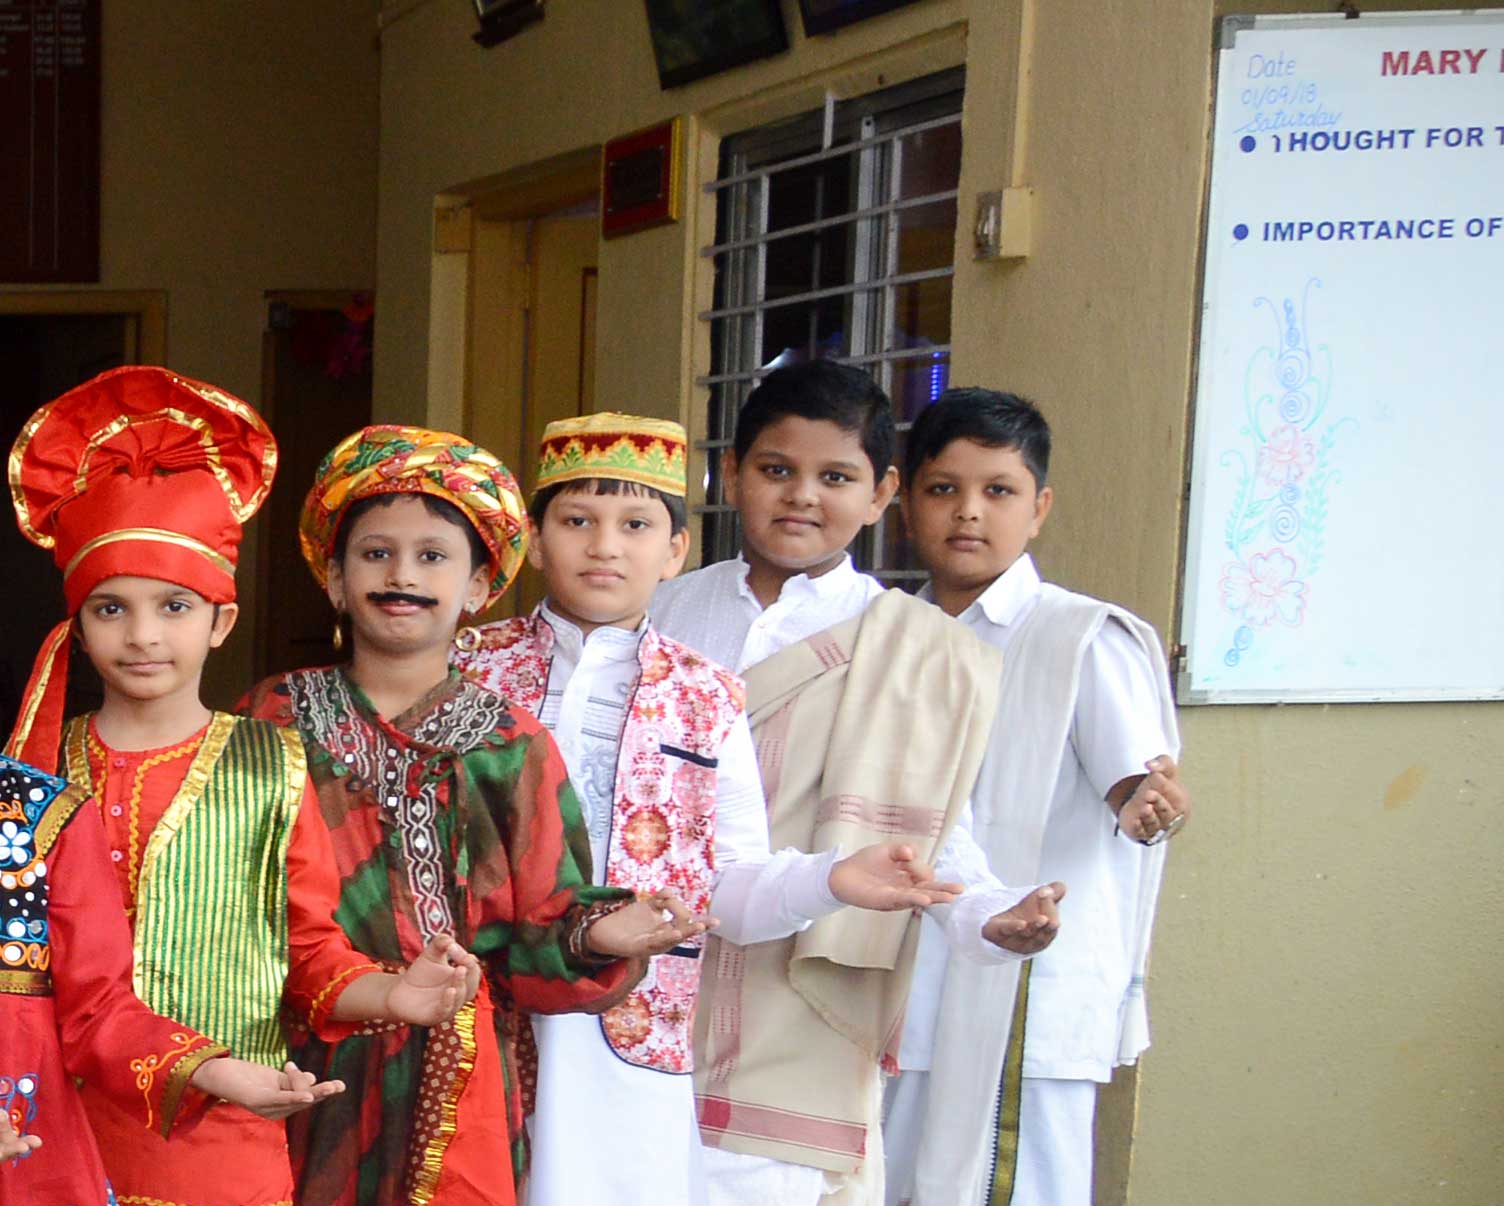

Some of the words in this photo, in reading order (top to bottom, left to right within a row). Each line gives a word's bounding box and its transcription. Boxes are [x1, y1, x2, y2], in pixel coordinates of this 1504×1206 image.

[1248, 51, 1296, 79] Date
[1381, 48, 1488, 77] MARY
[1233, 103, 1344, 134] Saturday
[1425, 127, 1485, 149] FOR
[1262, 219, 1456, 242] IMPORTANCE
[1466, 217, 1503, 238] OF
